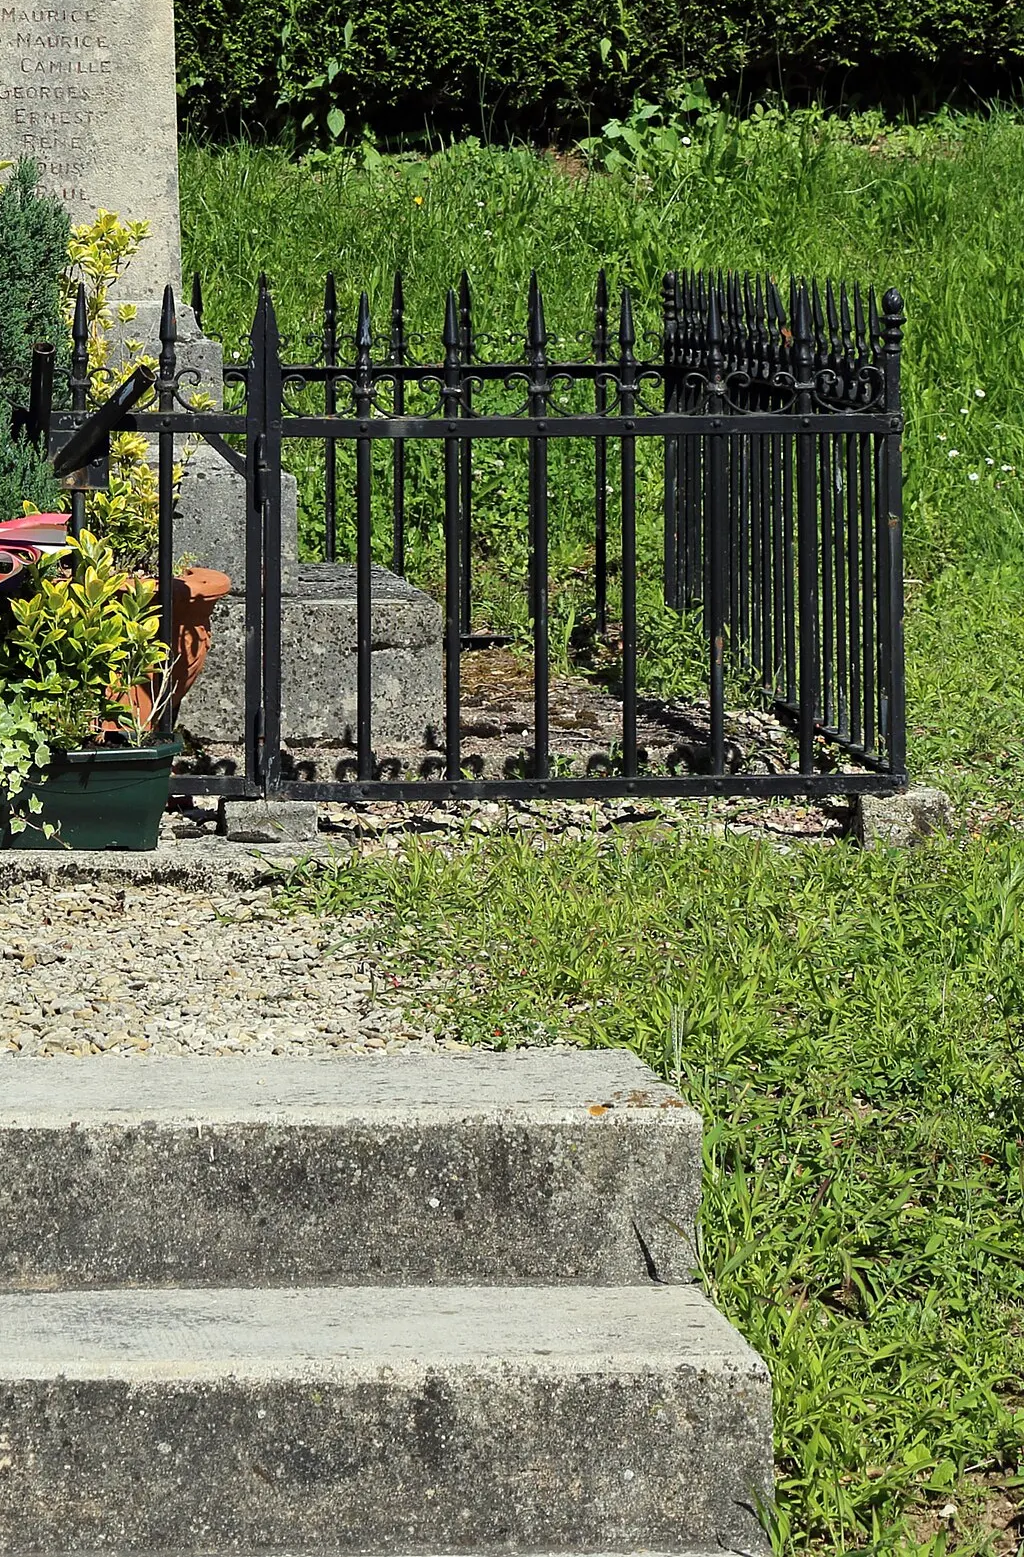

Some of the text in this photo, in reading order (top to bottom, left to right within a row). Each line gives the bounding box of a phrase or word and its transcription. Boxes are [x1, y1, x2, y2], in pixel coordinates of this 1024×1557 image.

[1, 7, 96, 23] MAURICE
[17, 32, 109, 48] MAURICE
[21, 57, 111, 74] CAMILLE
[15, 108, 93, 124] ERNEST
[36, 162, 85, 177] OUIS
